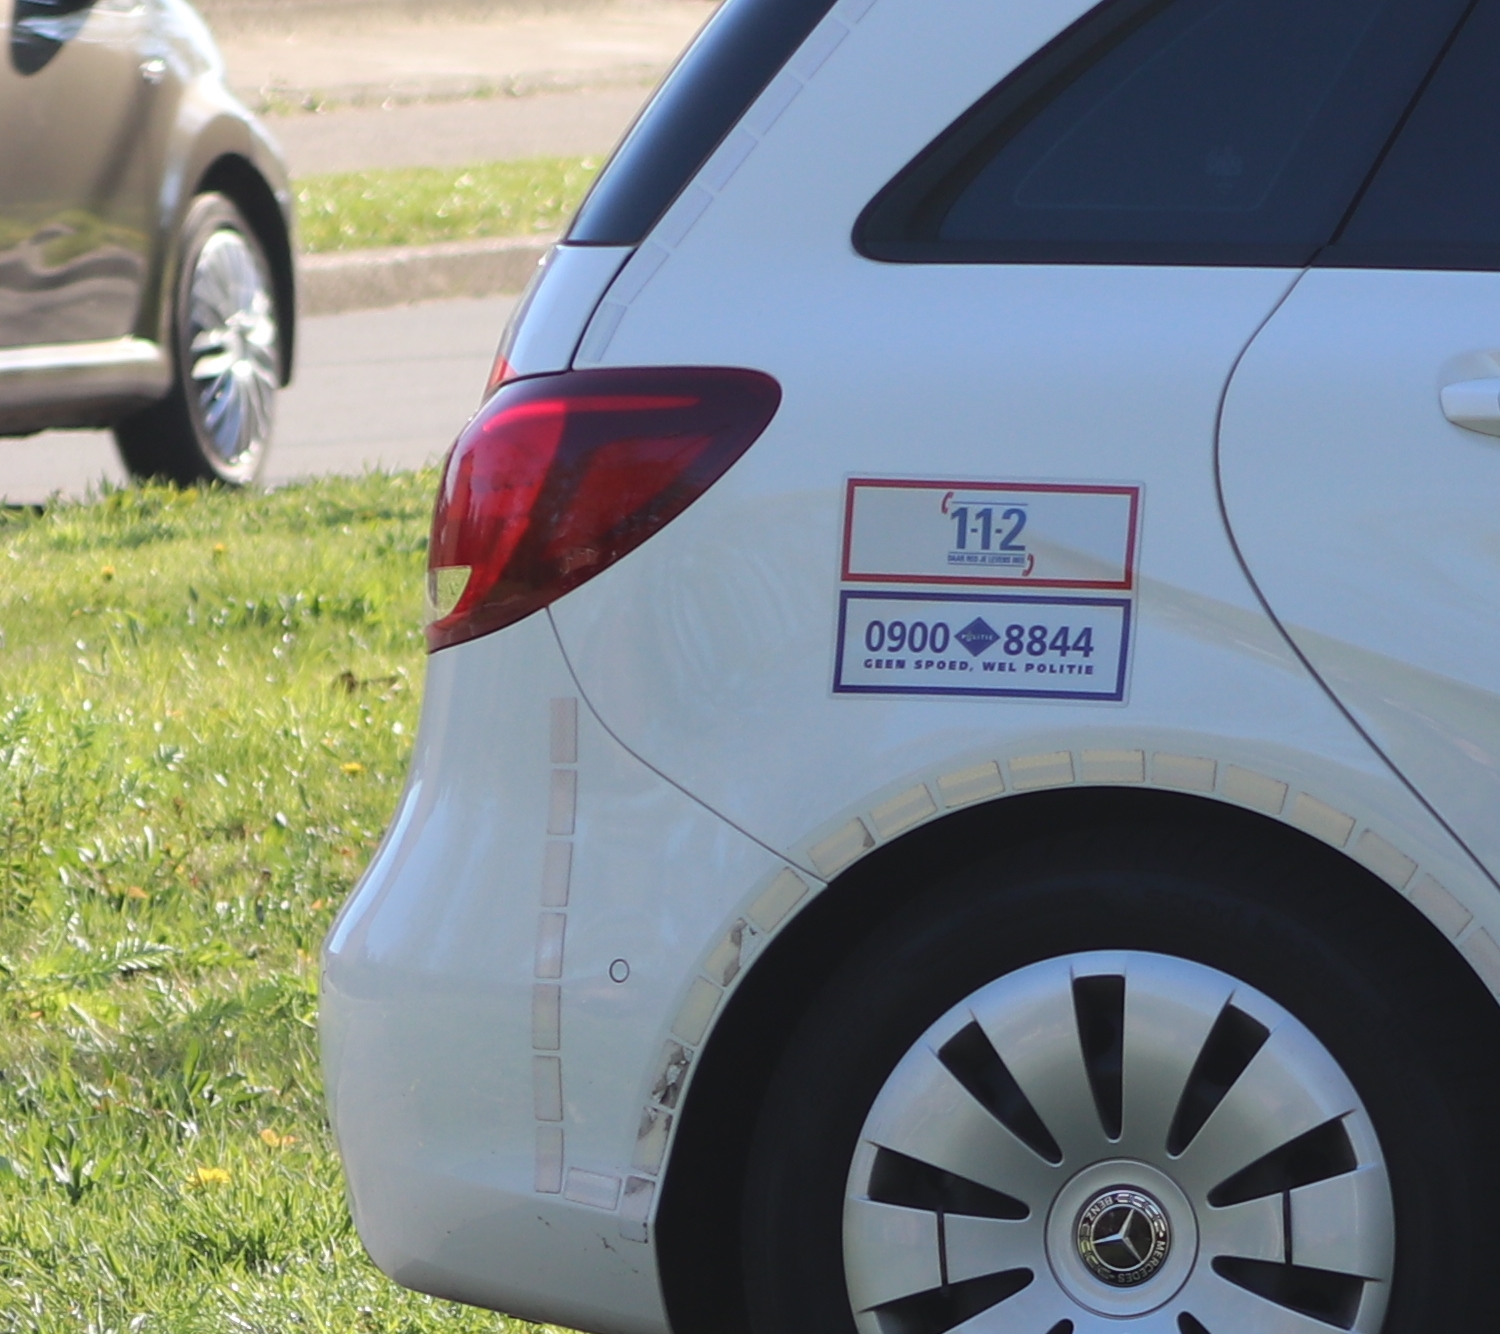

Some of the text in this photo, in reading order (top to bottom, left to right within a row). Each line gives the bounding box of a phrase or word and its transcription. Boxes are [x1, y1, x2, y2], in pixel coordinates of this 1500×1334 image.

[864, 620, 950, 654] 0900
[1003, 623, 1095, 658] 8844
[863, 658, 1095, 676] GEEN SPOED, WEL POLITIE
[1085, 1195, 1114, 1222] BENZ
[1117, 1240, 1167, 1283] MERCEDES
